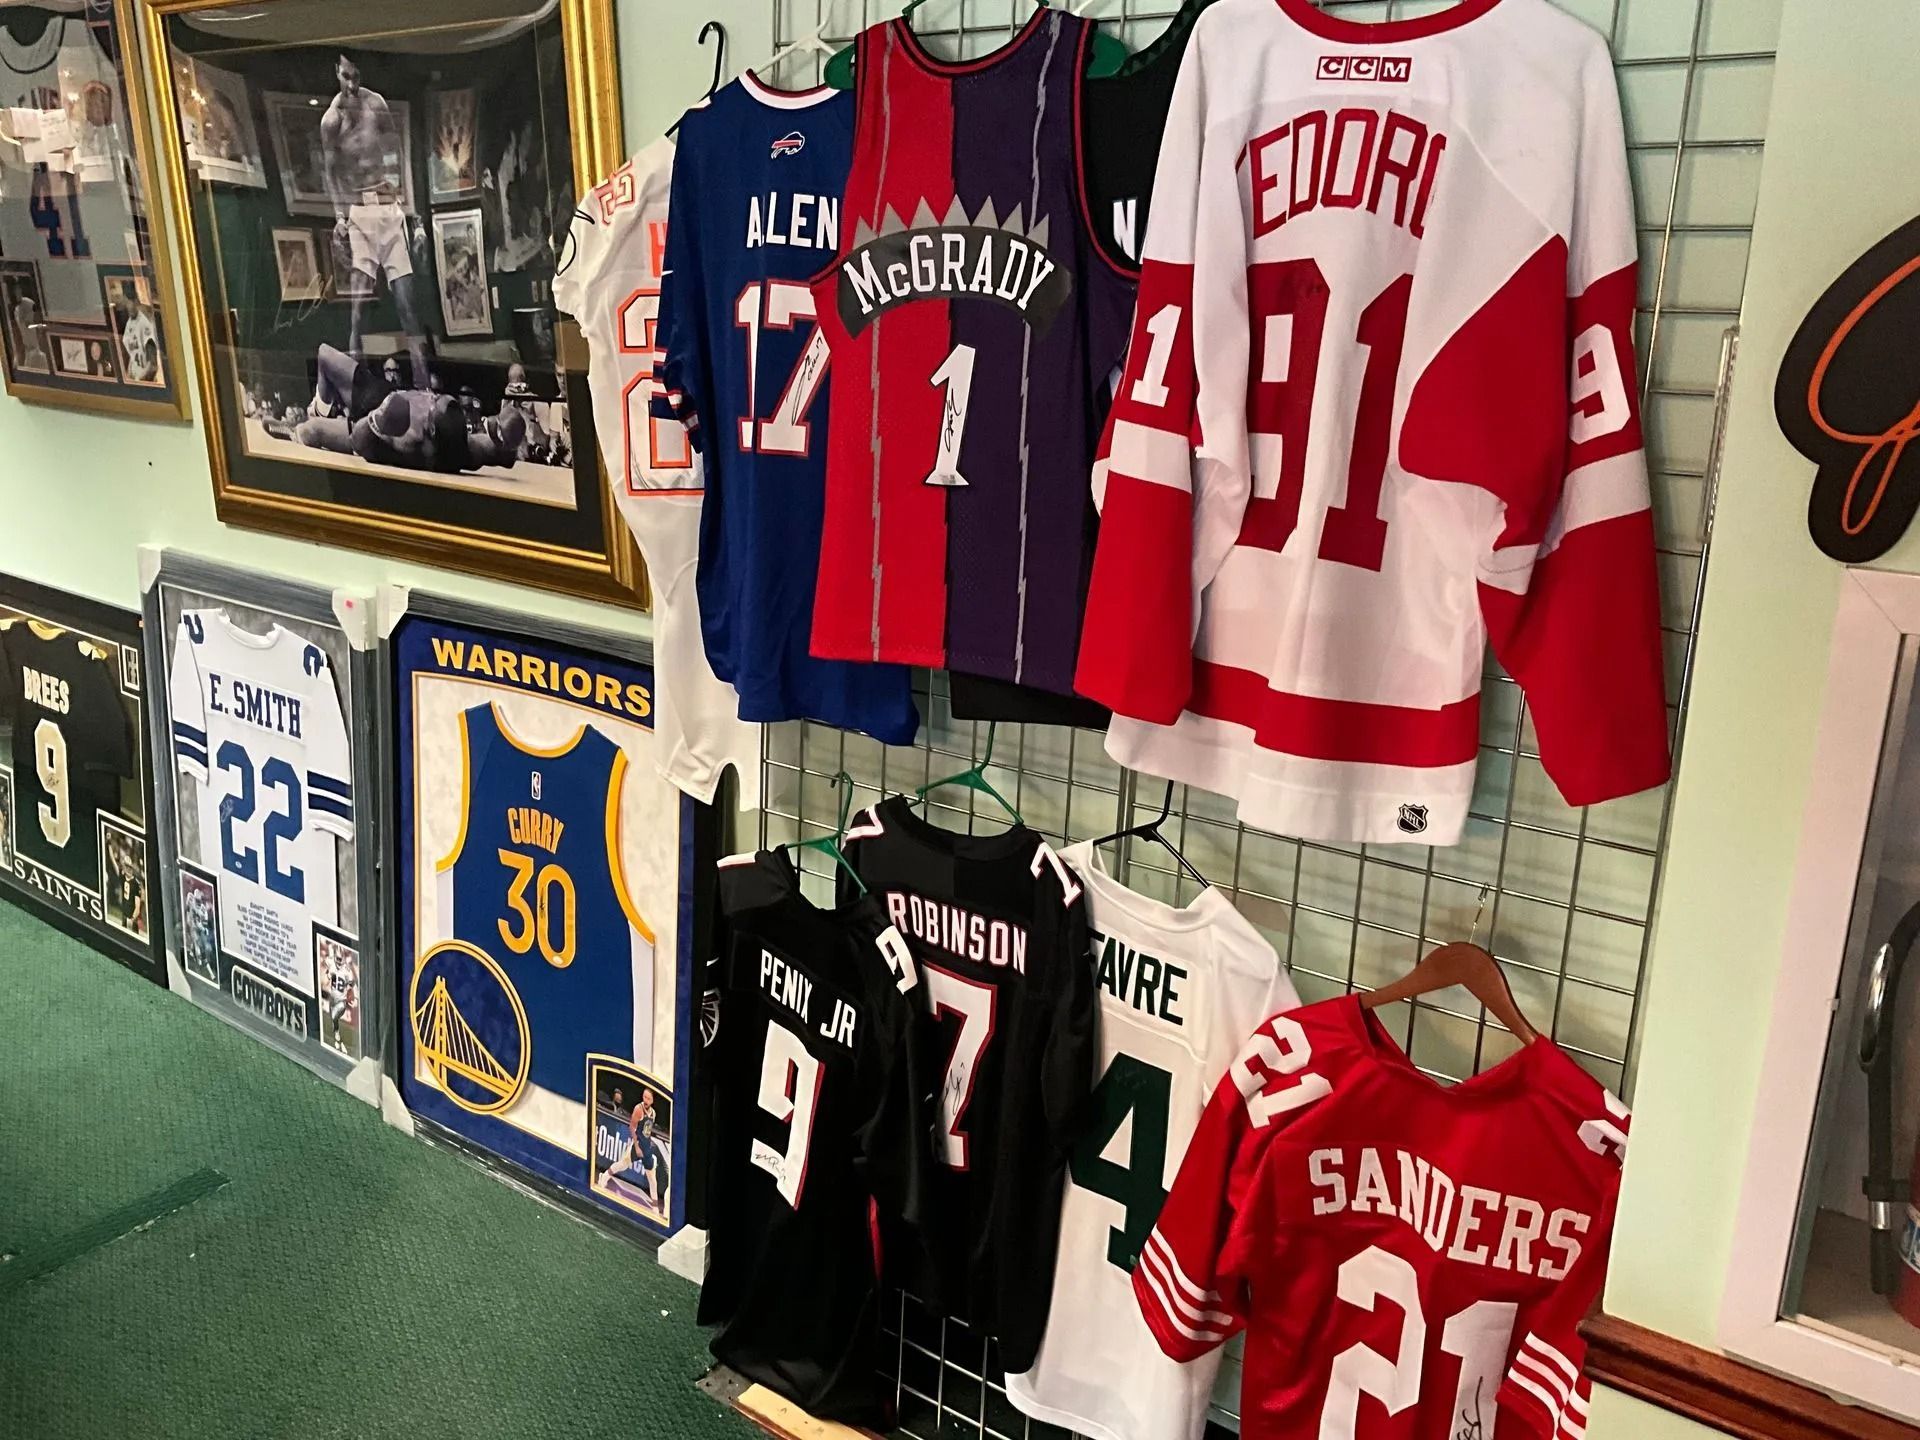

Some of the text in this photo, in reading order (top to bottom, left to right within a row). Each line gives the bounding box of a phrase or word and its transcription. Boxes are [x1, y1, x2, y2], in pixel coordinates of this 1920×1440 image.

[1316, 56, 1412, 82] CCM
[1235, 108, 1448, 241] EDOR
[843, 233, 1055, 315] McGRADY
[735, 278, 831, 459] 17
[924, 343, 977, 486] 1
[1235, 258, 1414, 573] 91
[1570, 323, 1632, 445] 9
[23, 665, 70, 715] BREES
[208, 672, 303, 740] E. SMITH
[431, 637, 651, 718] WARRIORS
[34, 718, 71, 848] 9
[216, 739, 306, 905] 22
[507, 807, 564, 855] CURRY
[14, 859, 104, 921] SAINTS
[497, 848, 577, 969] 30
[886, 892, 1028, 977] ROBINSON
[233, 970, 305, 1034] COWBOYS
[761, 949, 856, 1048] PENIX JR
[749, 1020, 826, 1211] 9
[921, 959, 998, 1171] 7
[1229, 1016, 1334, 1129] 21
[1065, 1051, 1173, 1276] 4
[1308, 1147, 1592, 1282] SANDERS
[1317, 1244, 1519, 1440] 21
